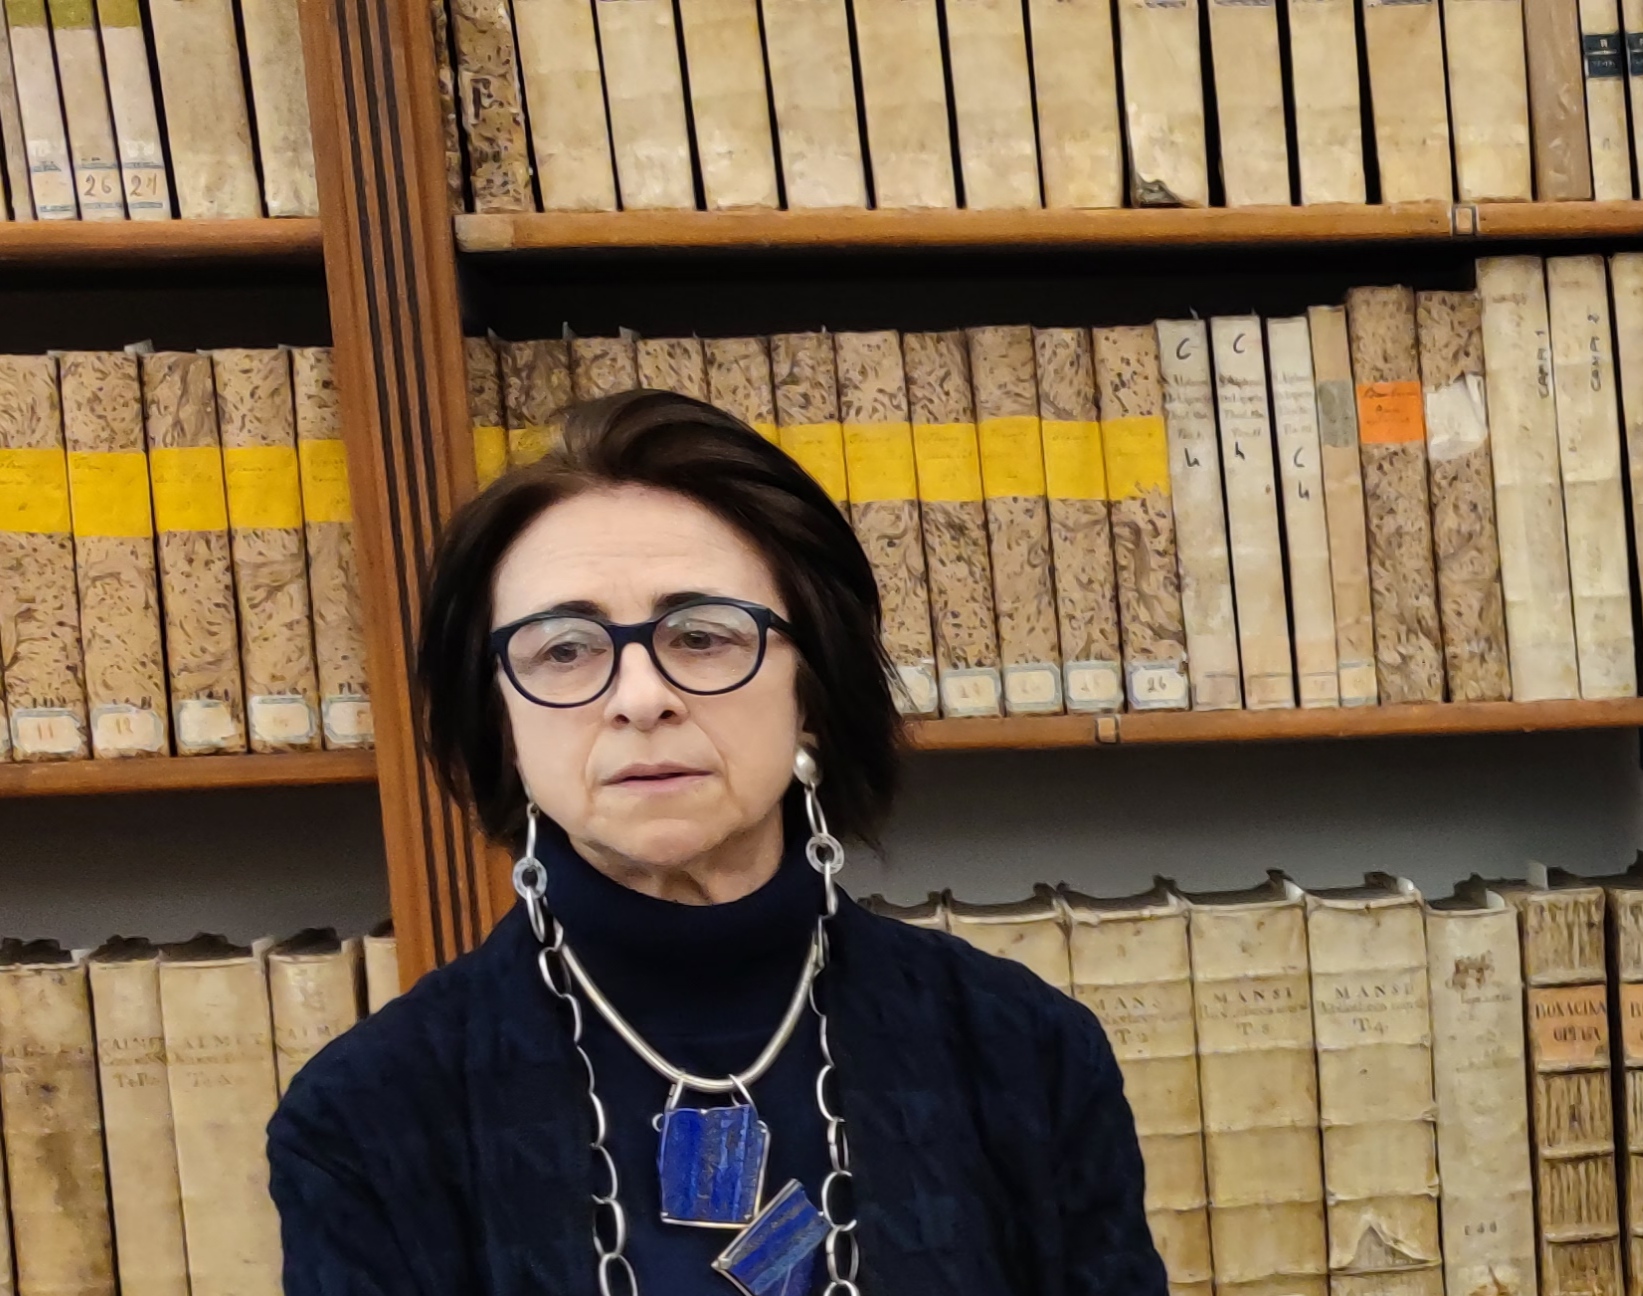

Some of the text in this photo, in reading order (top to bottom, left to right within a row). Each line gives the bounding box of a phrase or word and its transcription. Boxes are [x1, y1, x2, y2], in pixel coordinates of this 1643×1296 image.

[83, 174, 112, 197] 26
[1212, 985, 1294, 1004] MANSI
[1334, 983, 1415, 1000] MANSI
